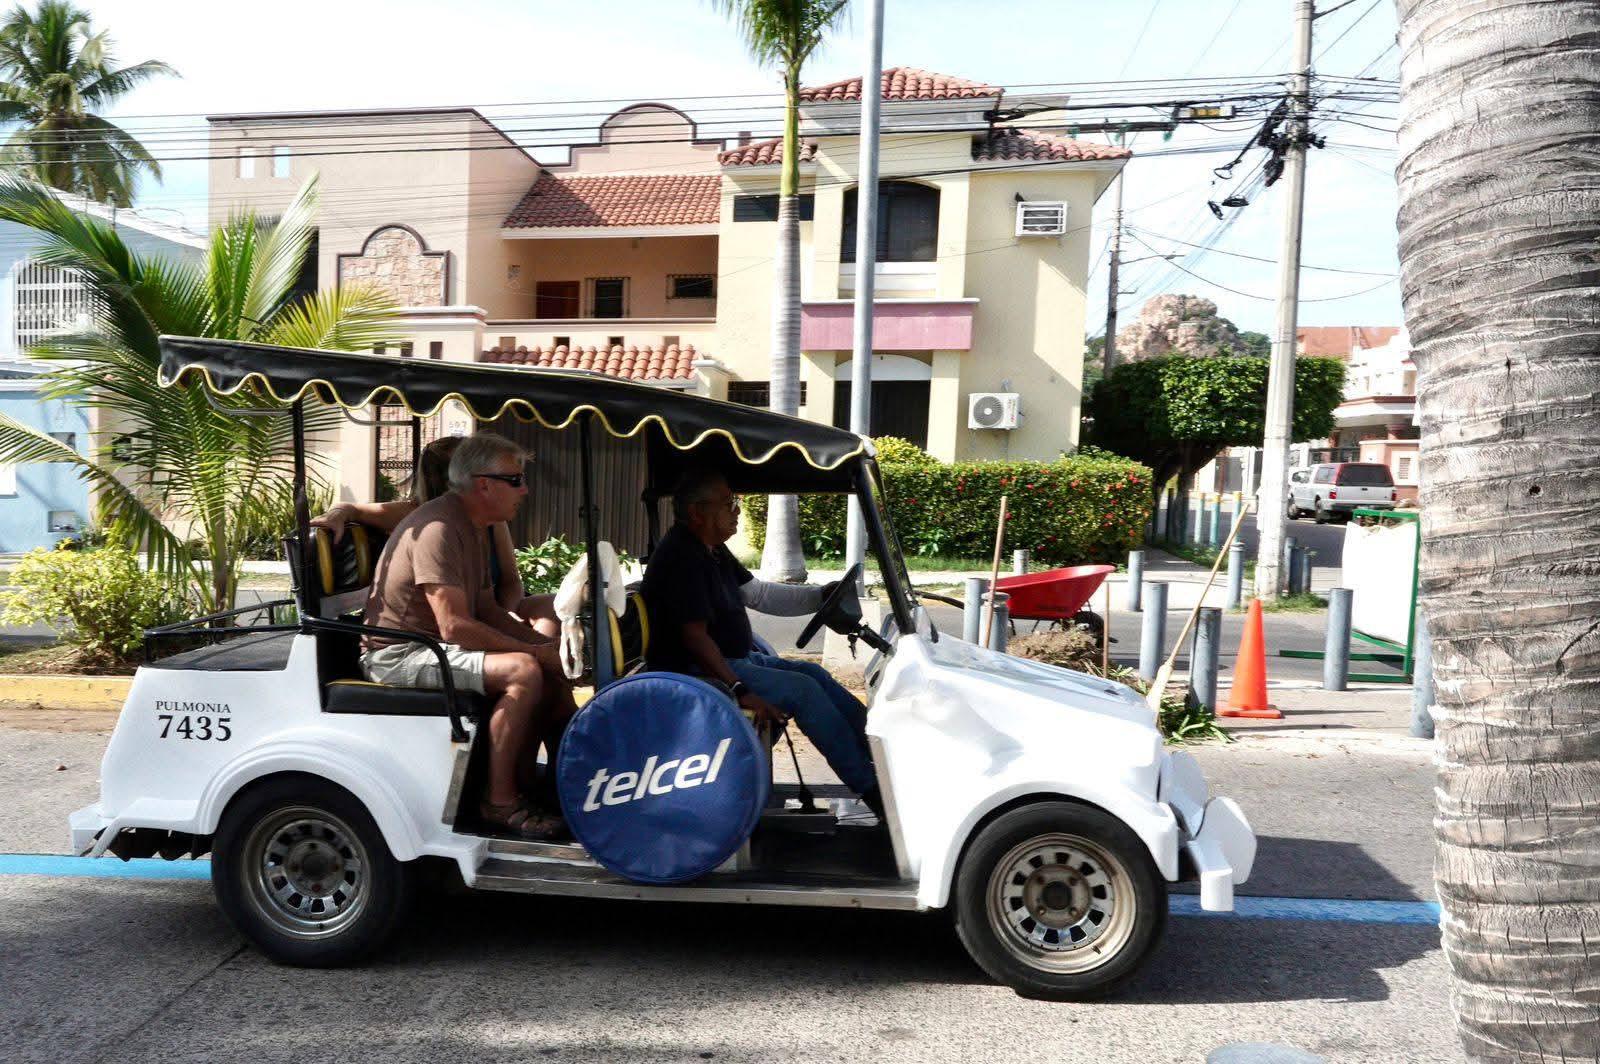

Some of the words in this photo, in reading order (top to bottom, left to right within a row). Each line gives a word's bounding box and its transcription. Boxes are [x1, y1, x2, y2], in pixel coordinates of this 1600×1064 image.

[155, 701, 231, 713] PULMONIA
[158, 714, 231, 742] 7435
[583, 737, 732, 812] telcel
